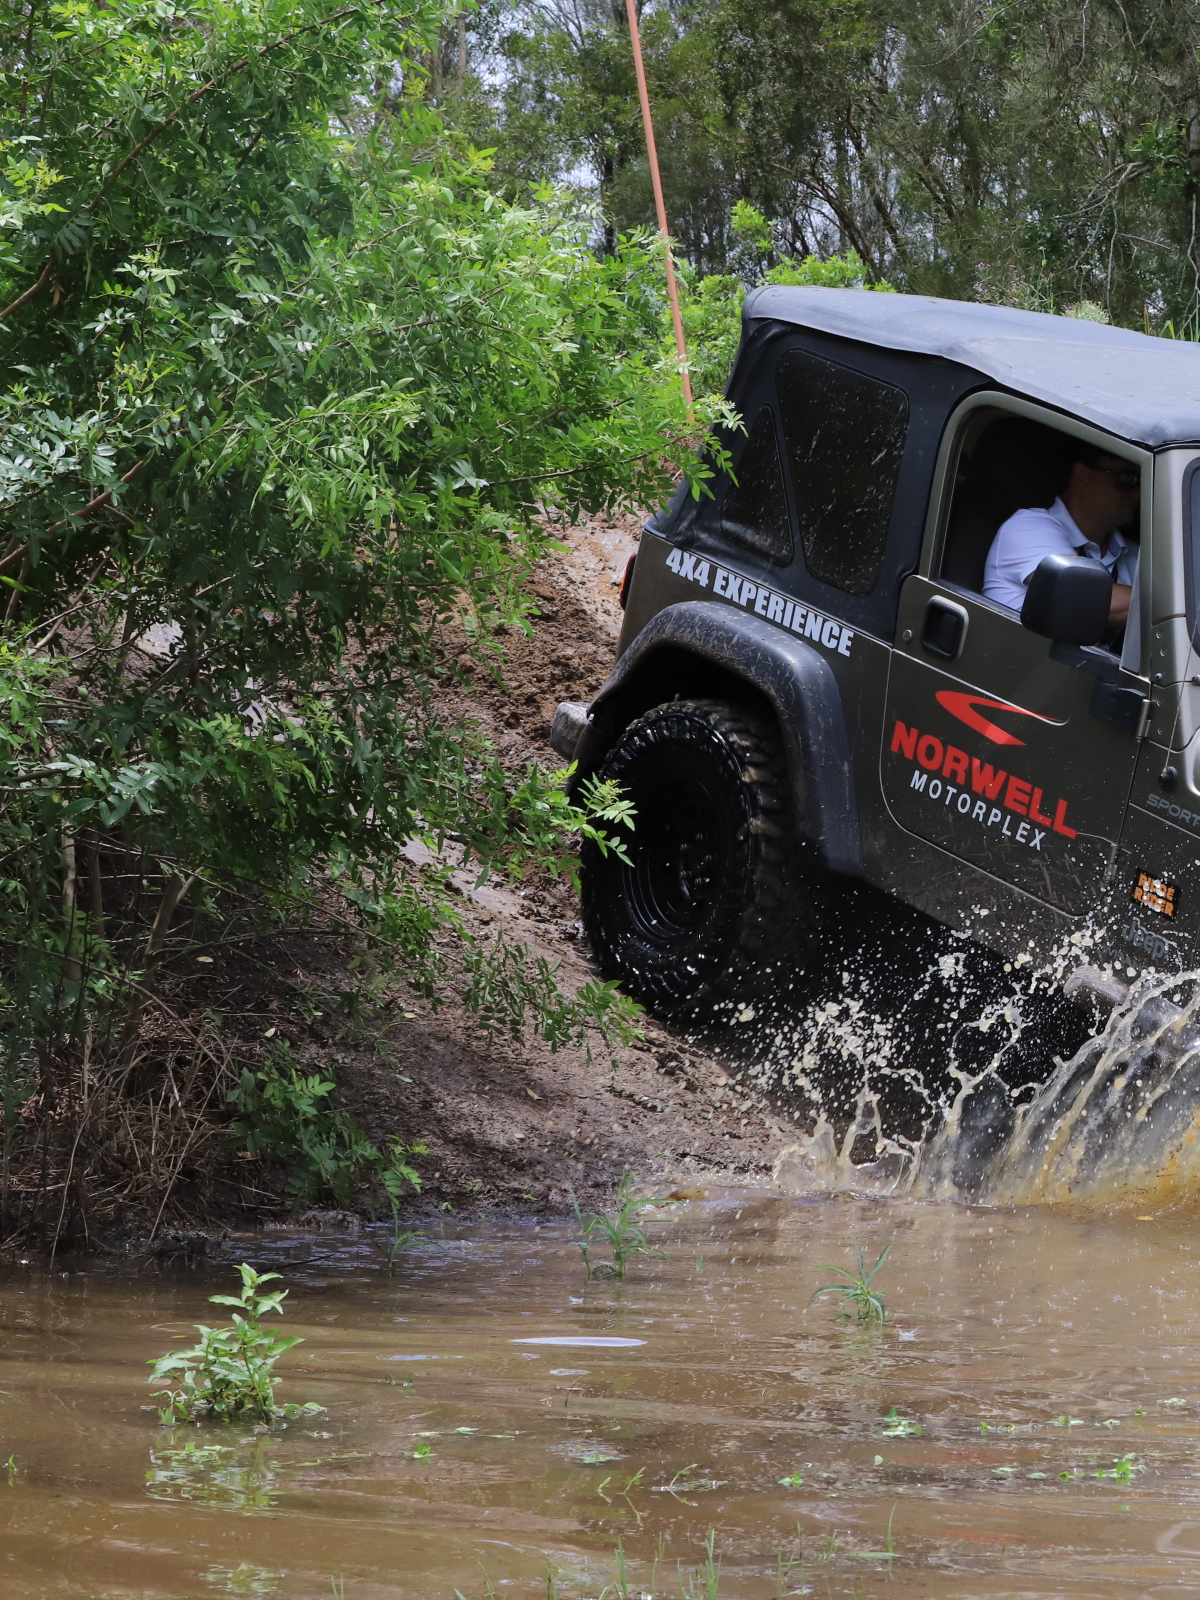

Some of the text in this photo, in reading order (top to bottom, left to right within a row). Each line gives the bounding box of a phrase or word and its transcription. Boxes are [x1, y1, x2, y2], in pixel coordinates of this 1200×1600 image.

[665, 547, 855, 658] 4X4 EXPERIENCE
[890, 720, 1078, 840] NORWELL
[909, 769, 1047, 851] MOTORPLEX
[1121, 917, 1166, 961] Jeep
